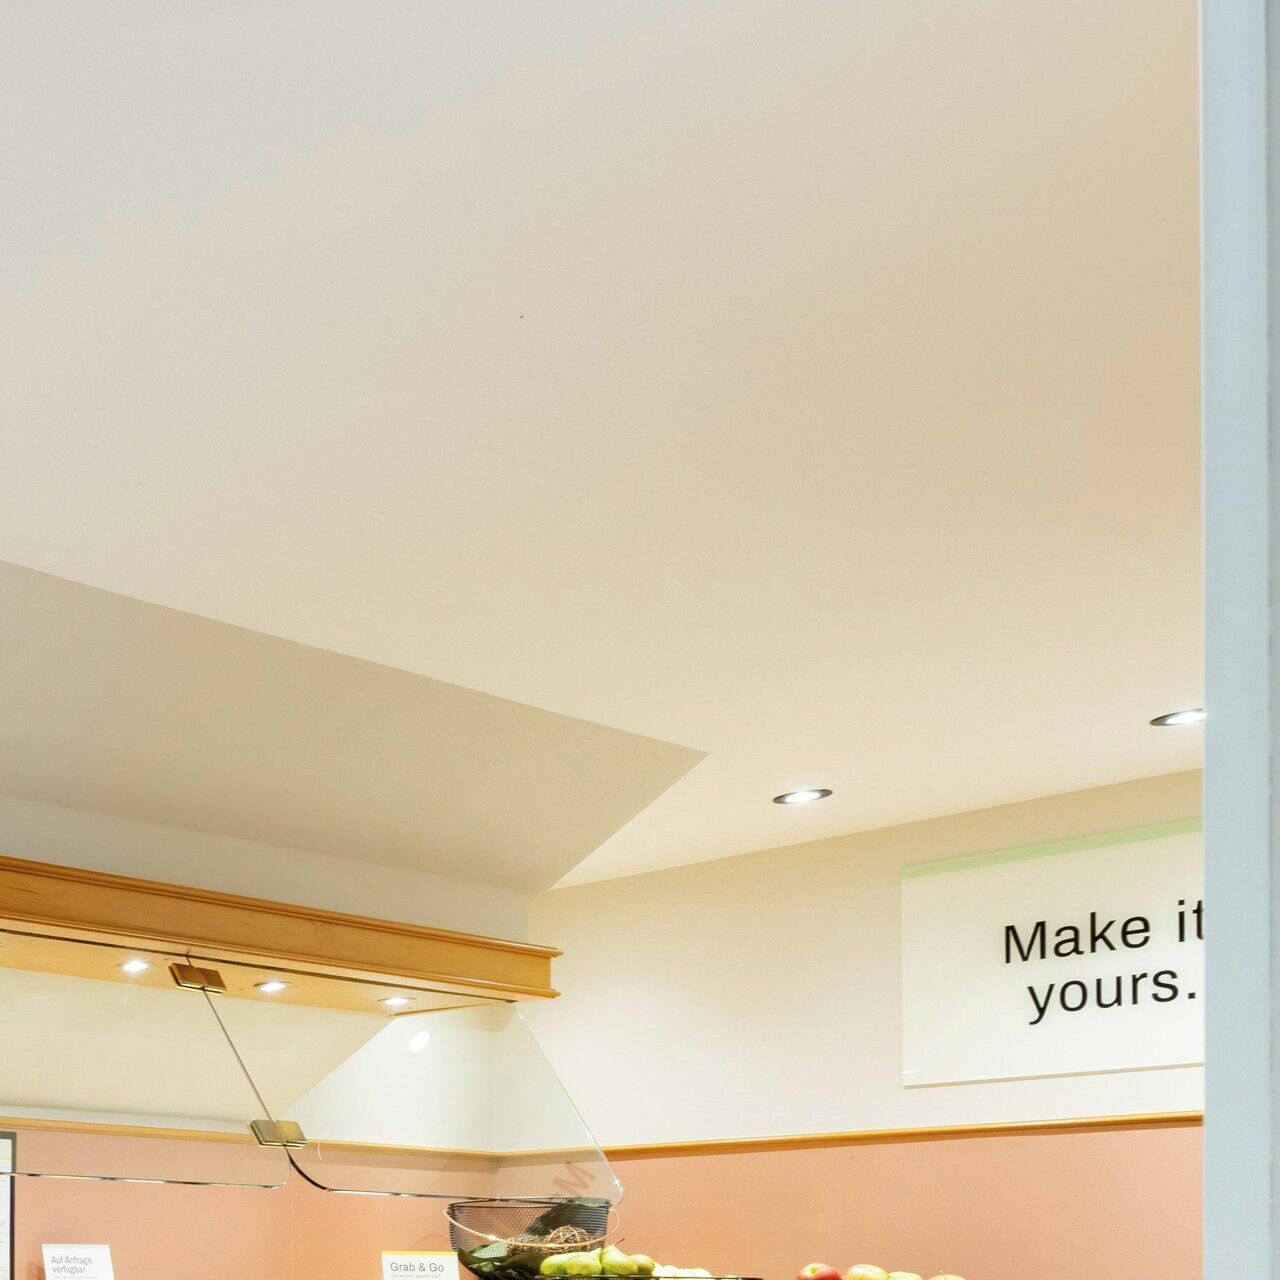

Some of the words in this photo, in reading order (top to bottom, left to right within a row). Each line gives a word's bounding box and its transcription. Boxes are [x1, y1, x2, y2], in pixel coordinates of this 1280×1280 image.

[1004, 911, 1151, 964] Make
[1178, 899, 1204, 942] it
[1027, 969, 1196, 1026] yours.
[51, 1256, 63, 1264] Auf
[65, 1256, 93, 1266] Anfrage
[390, 1262, 415, 1272] Grab
[418, 1262, 426, 1272] &
[429, 1262, 444, 1273] Go
